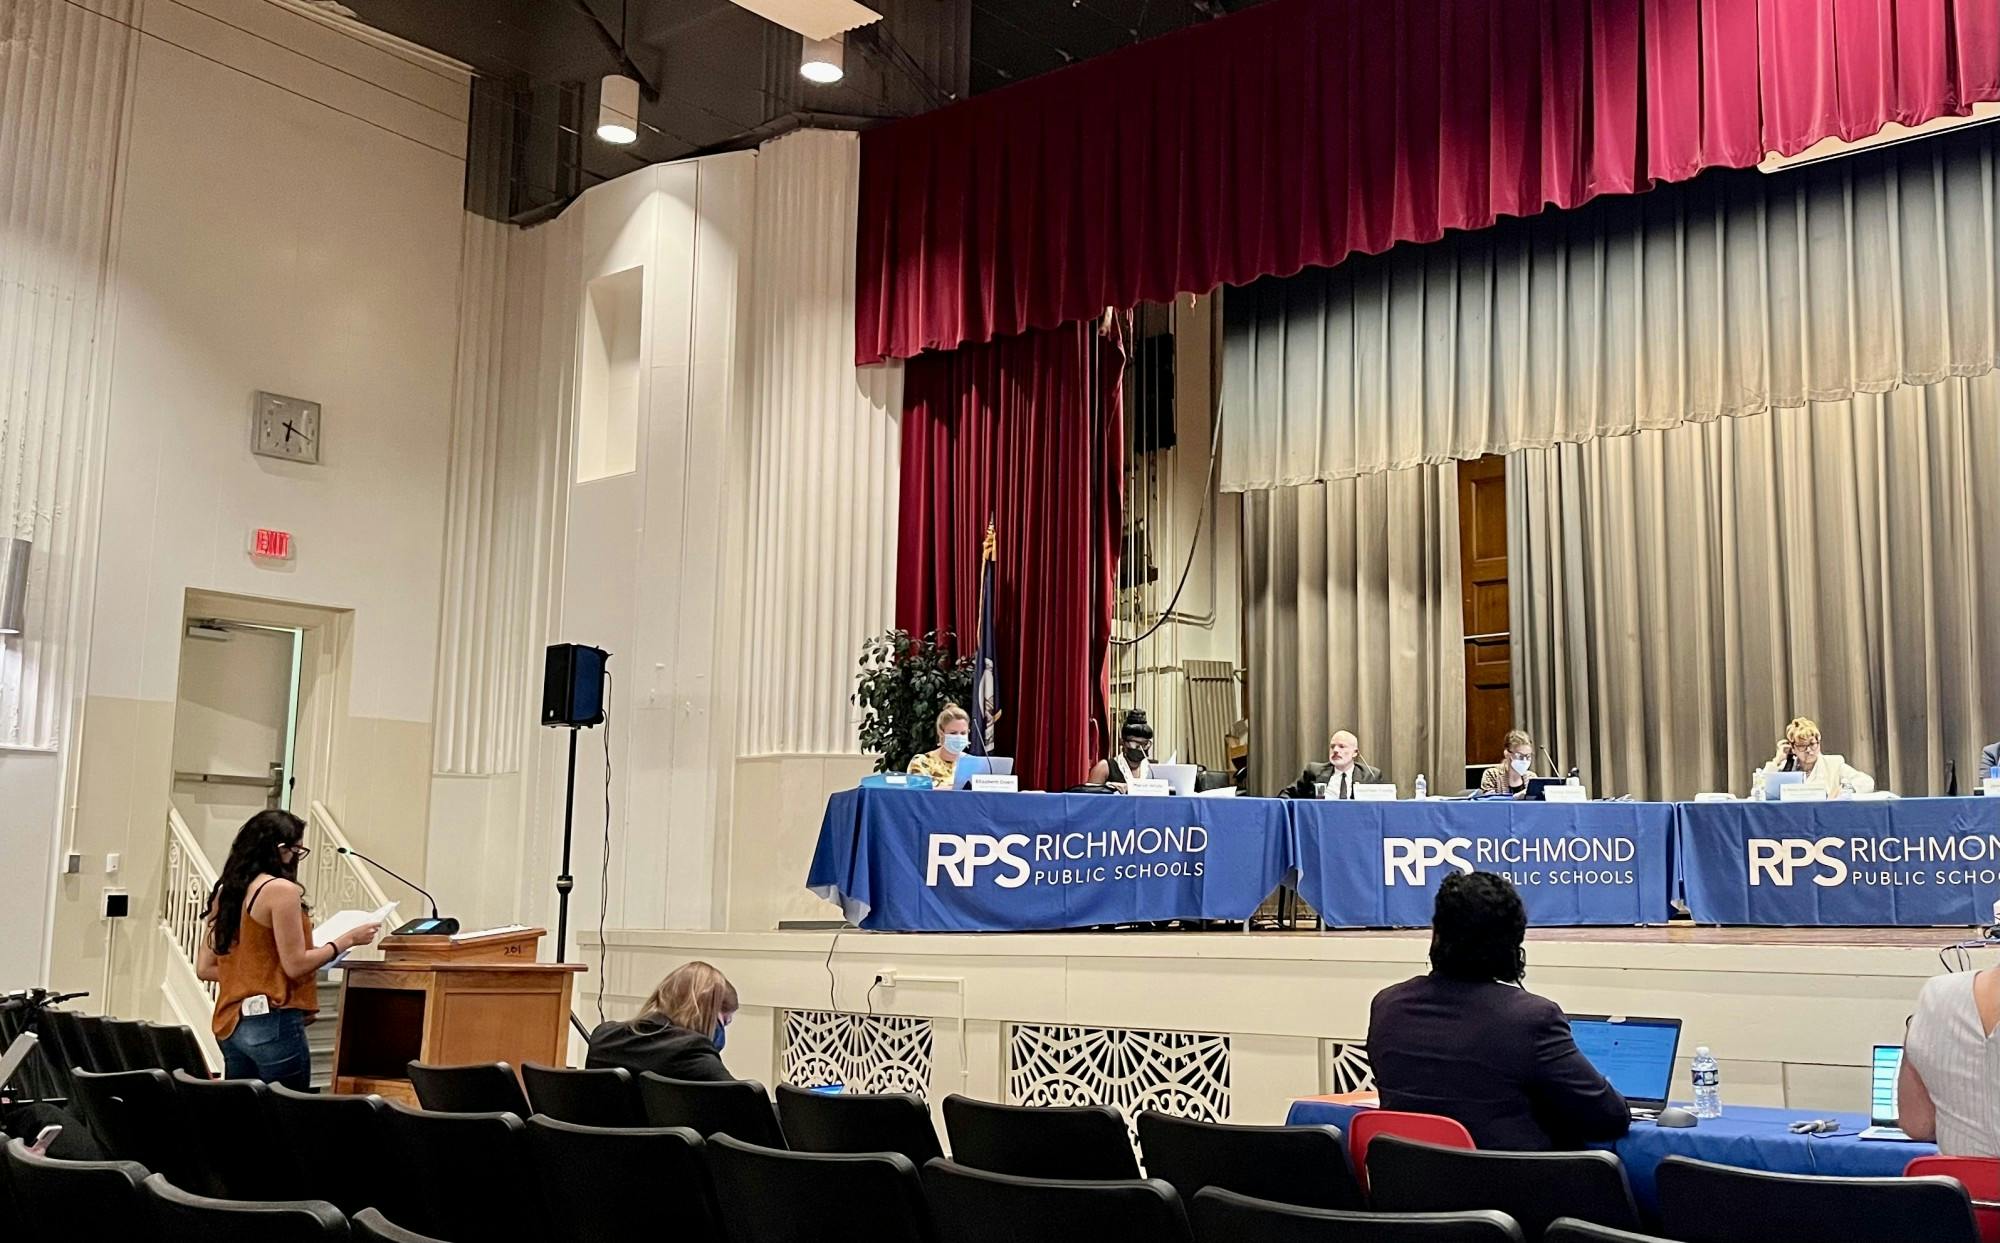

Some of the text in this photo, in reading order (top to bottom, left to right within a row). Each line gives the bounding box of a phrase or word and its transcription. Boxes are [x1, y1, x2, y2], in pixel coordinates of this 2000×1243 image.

[256, 529, 289, 557] EXIT
[1034, 826, 1208, 861] RICHMOND
[1477, 837, 1635, 863] RICHMOND
[926, 833, 1031, 888] RPS
[1034, 861, 1204, 886] PUBLIC SCHOOLS
[1383, 837, 1474, 886] RPS
[1748, 836, 1848, 887] RPS
[1497, 870, 1634, 885] BLIC SCHOOLS
[1852, 869, 2000, 885] PUBLIC SCHO
[503, 944, 522, 956] 201
